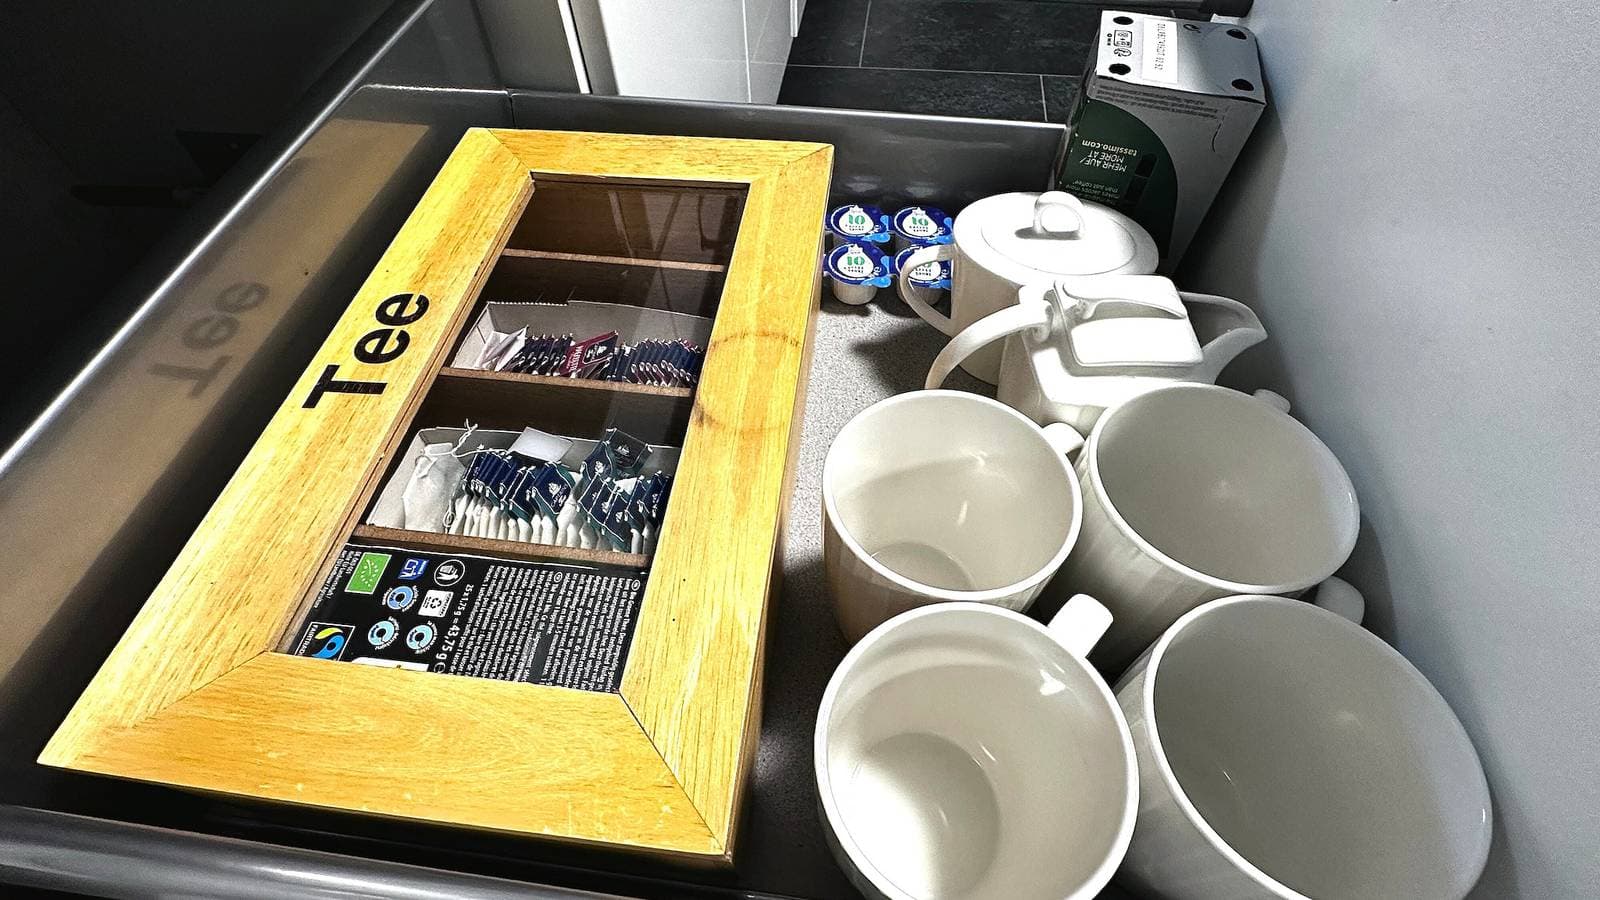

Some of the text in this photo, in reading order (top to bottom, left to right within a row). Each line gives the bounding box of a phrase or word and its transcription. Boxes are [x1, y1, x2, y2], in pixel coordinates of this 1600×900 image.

[1081, 139, 1138, 157] tassimo.com
[1087, 150, 1125, 164] MORE AT
[1080, 157, 1128, 172] MEHR AUF/
[848, 214, 866, 225] 10
[911, 216, 929, 226] 10
[847, 256, 866, 266] 10
[302, 293, 430, 409] Tee
[463, 583, 474, 591] 25
[456, 597, 469, 610] 1,75
[438, 623, 461, 651] 43,75
[434, 652, 449, 660] g
